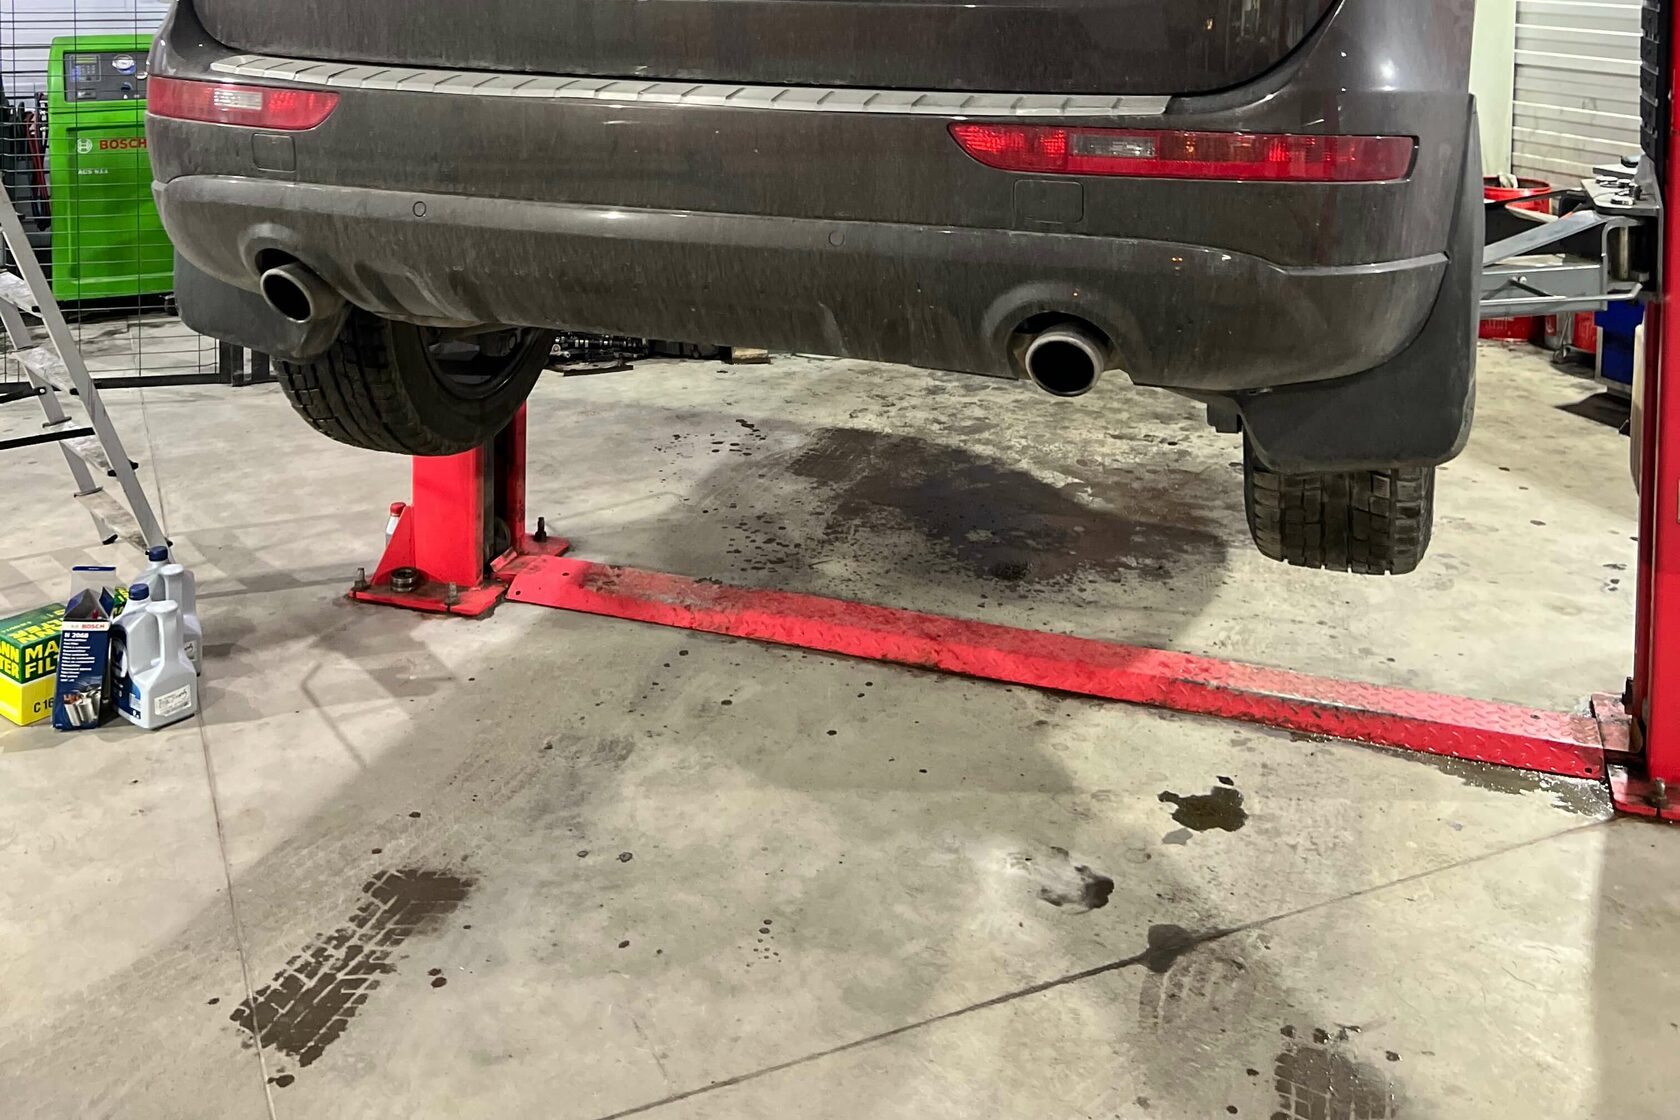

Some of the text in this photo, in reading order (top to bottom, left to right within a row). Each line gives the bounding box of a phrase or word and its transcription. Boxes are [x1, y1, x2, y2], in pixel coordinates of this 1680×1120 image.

[99, 137, 147, 150] BOSCH
[25, 640, 59, 663] MA
[0, 655, 19, 679] TER
[25, 655, 59, 678] FIL
[33, 701, 41, 713] C
